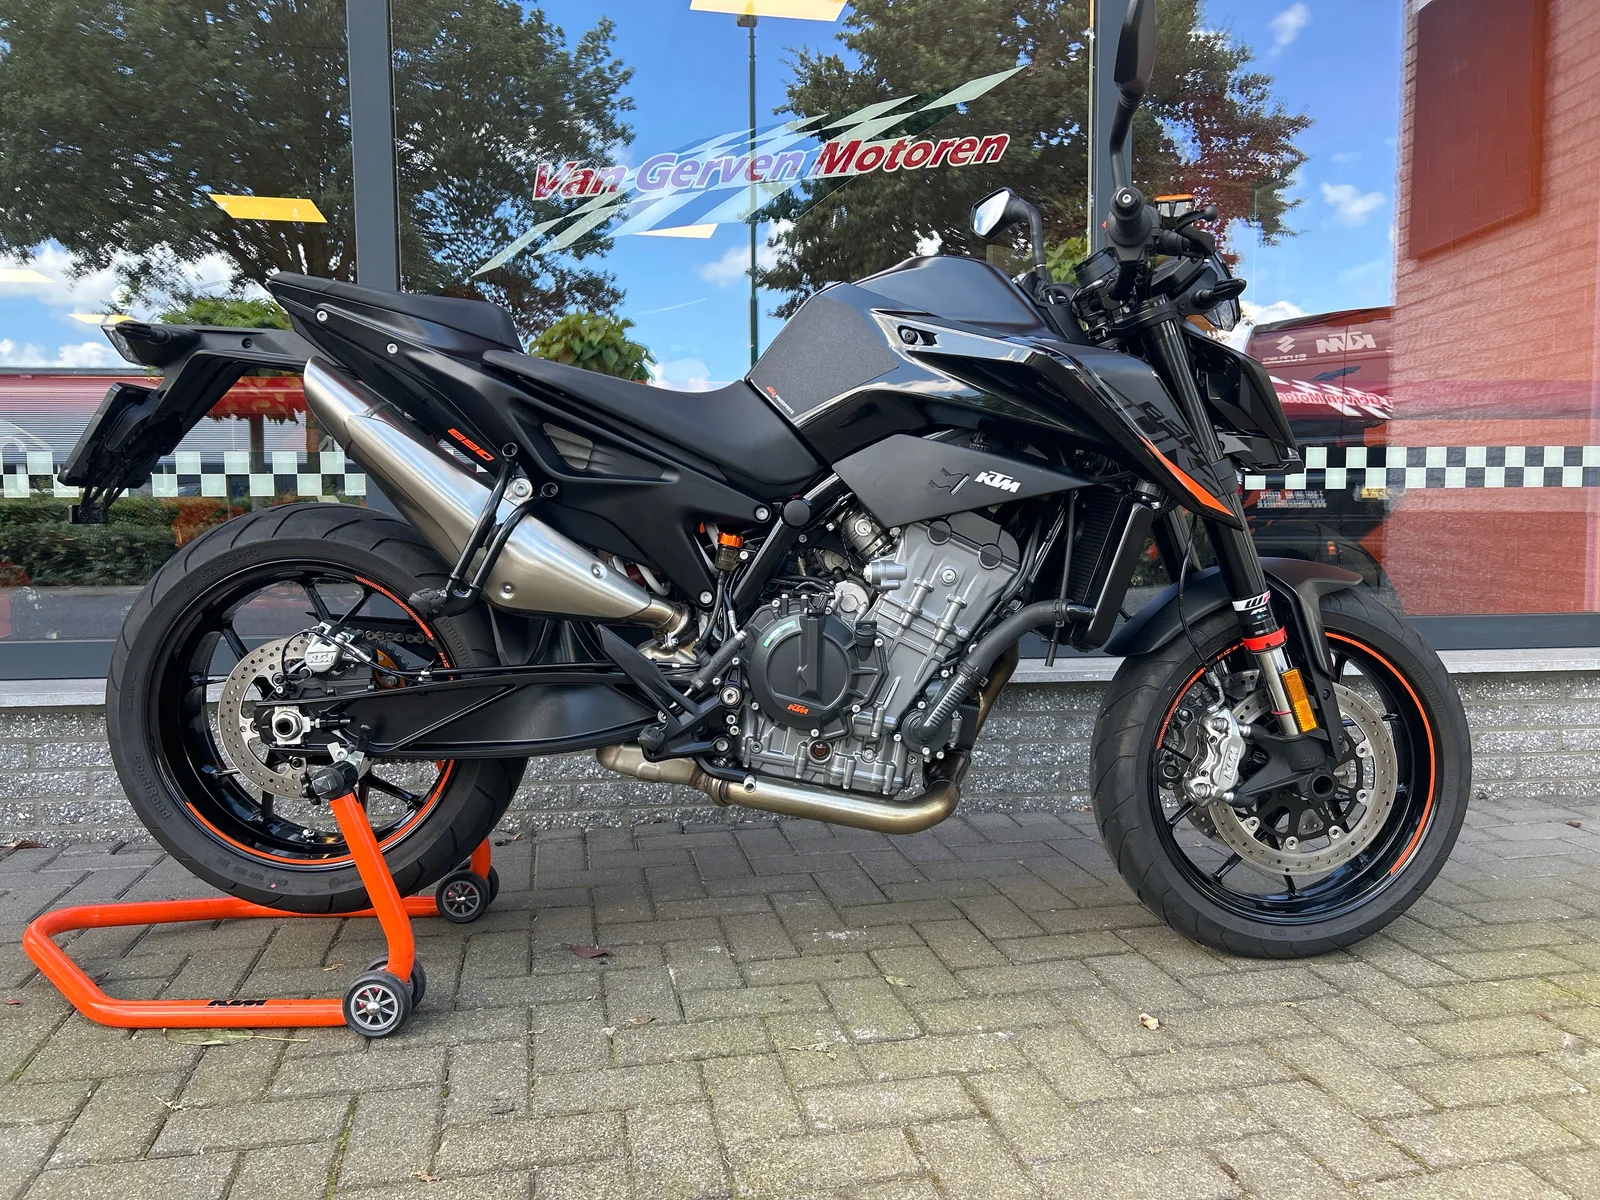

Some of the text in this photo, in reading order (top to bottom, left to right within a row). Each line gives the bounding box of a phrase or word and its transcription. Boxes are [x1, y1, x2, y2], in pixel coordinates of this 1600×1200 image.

[532, 133, 1011, 201] Van Gerven Motoren
[447, 428, 495, 461] 890
[974, 470, 1021, 494] KTM
[787, 703, 809, 715] KTM
[133, 752, 173, 820] ContiRoad
